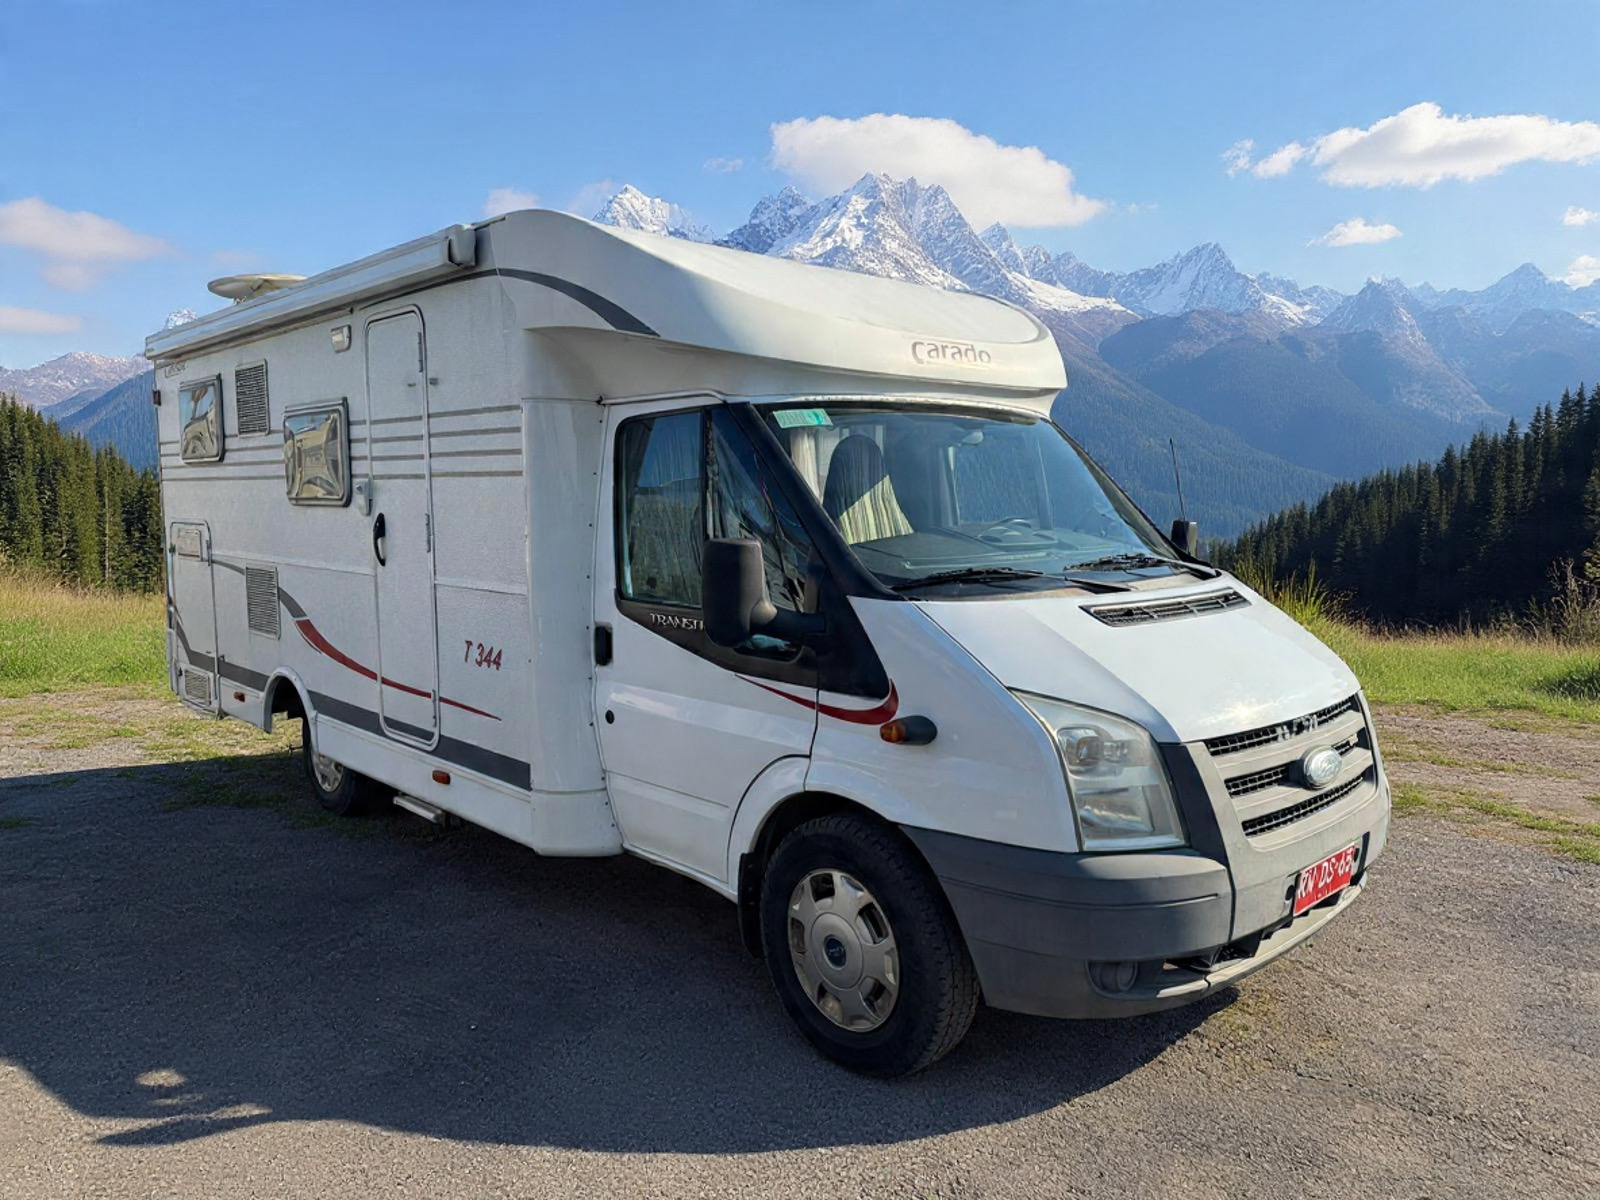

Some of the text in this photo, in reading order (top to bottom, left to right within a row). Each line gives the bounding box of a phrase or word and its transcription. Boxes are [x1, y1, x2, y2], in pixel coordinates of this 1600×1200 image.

[911, 340, 991, 365] Carado
[465, 639, 503, 671] T 344
